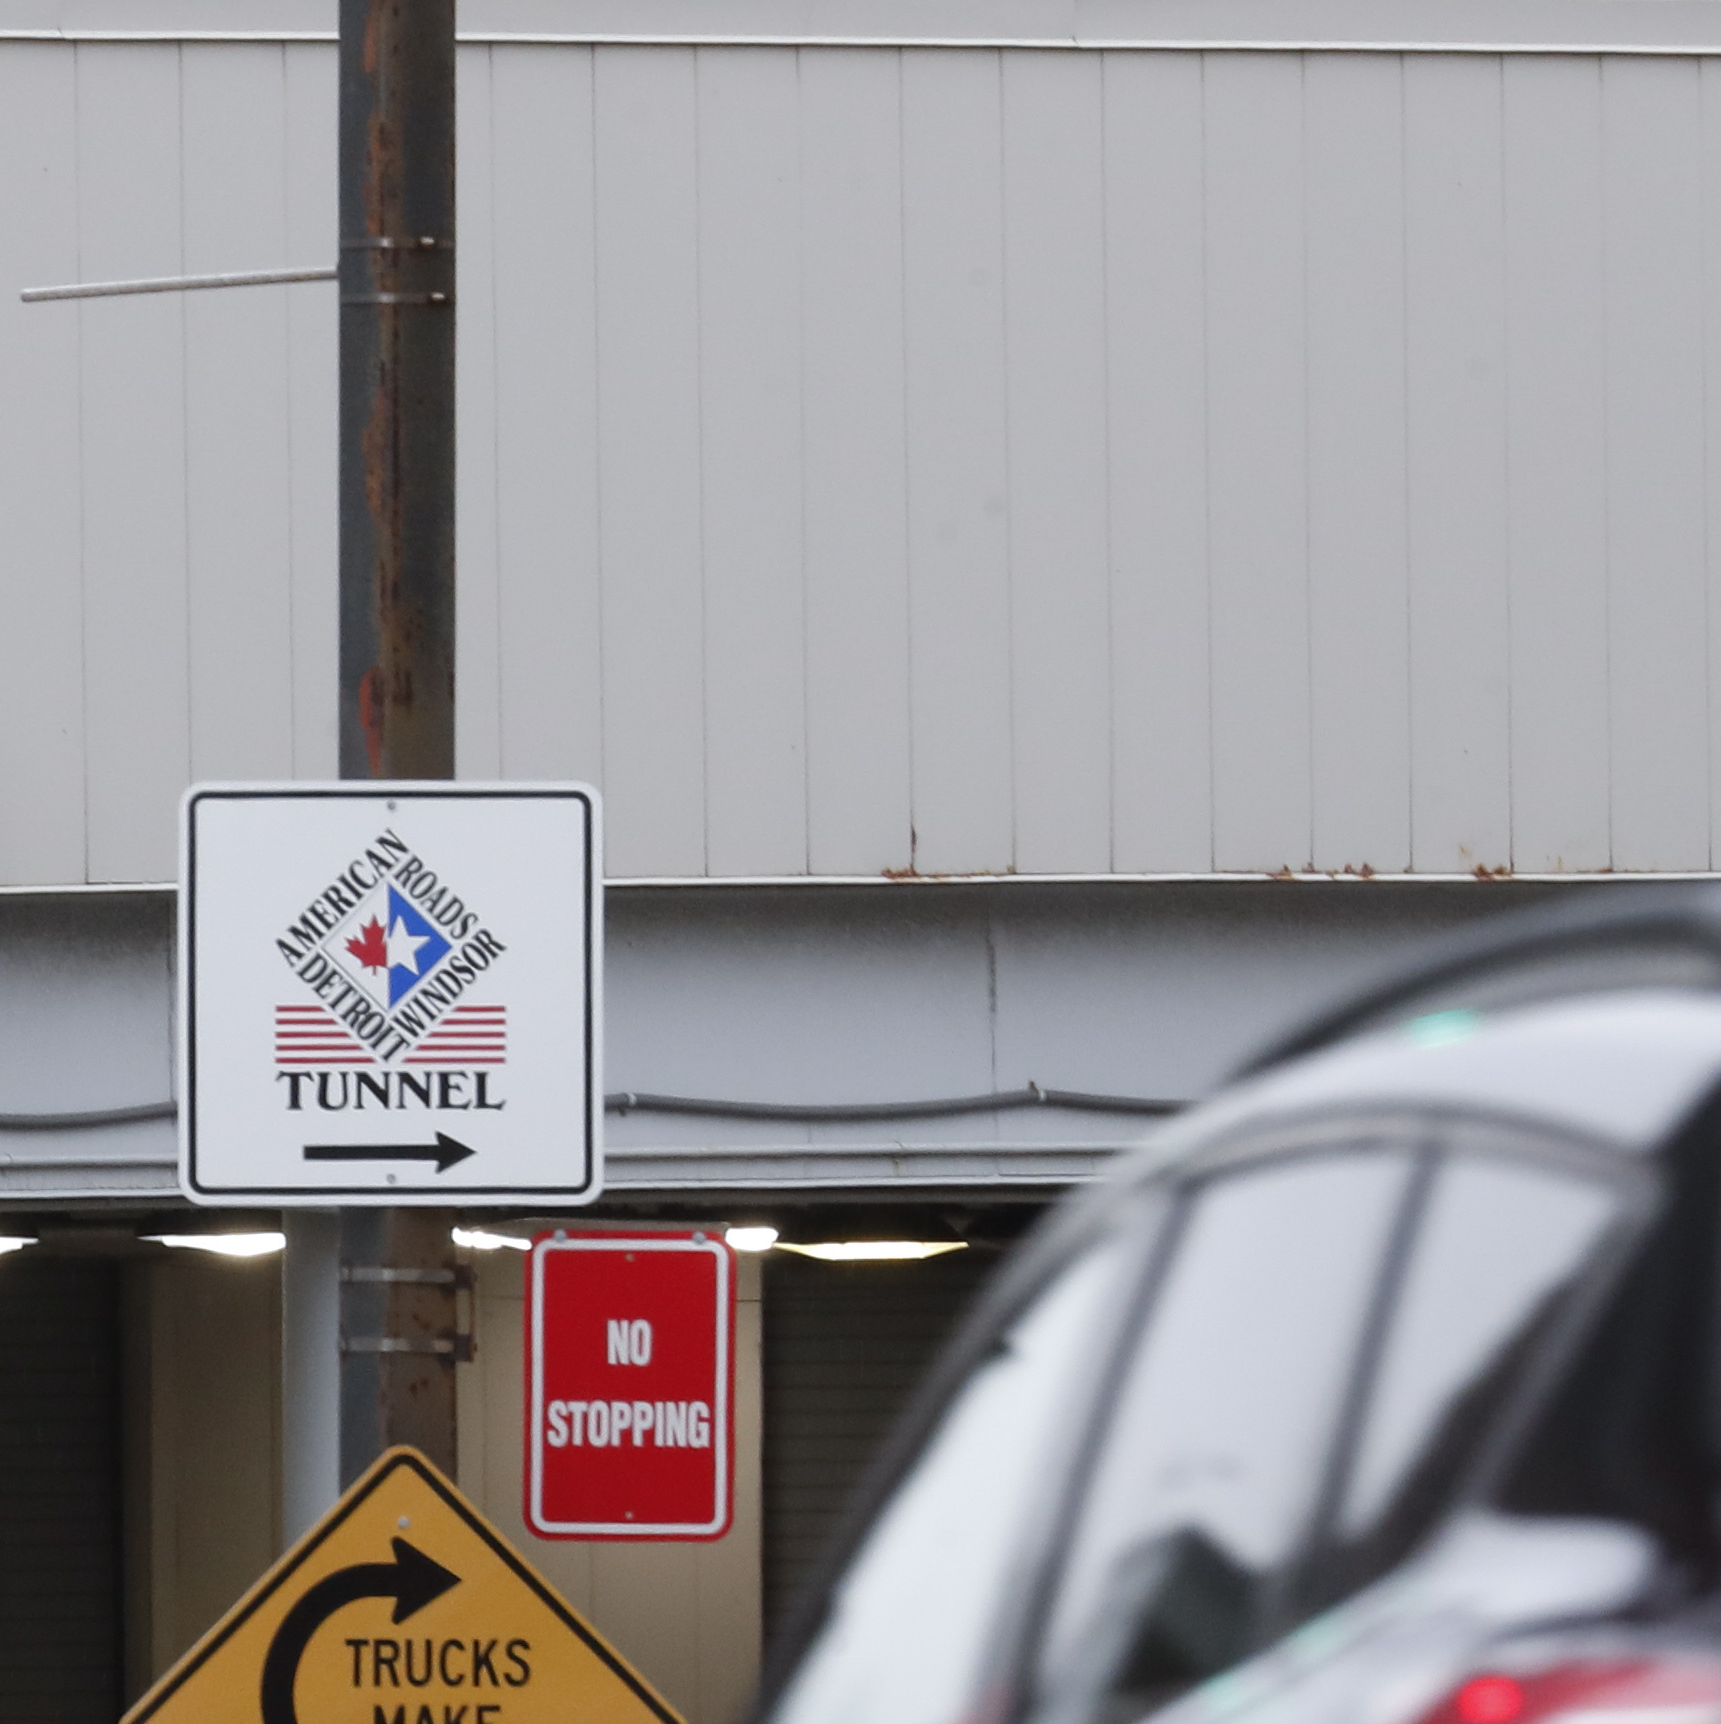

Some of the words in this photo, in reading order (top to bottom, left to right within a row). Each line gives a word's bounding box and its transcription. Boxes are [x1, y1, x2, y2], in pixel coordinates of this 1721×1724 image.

[275, 827, 410, 968] AMERICAN
[393, 855, 479, 940] ROADS
[295, 952, 411, 1063] DETROIT
[392, 928, 507, 1040] WINDSOR
[276, 1070, 506, 1111] TUNNEL
[607, 1319, 652, 1366] NO
[547, 1400, 710, 1448] STOPPING
[345, 1638, 531, 1687] TRUCKS
